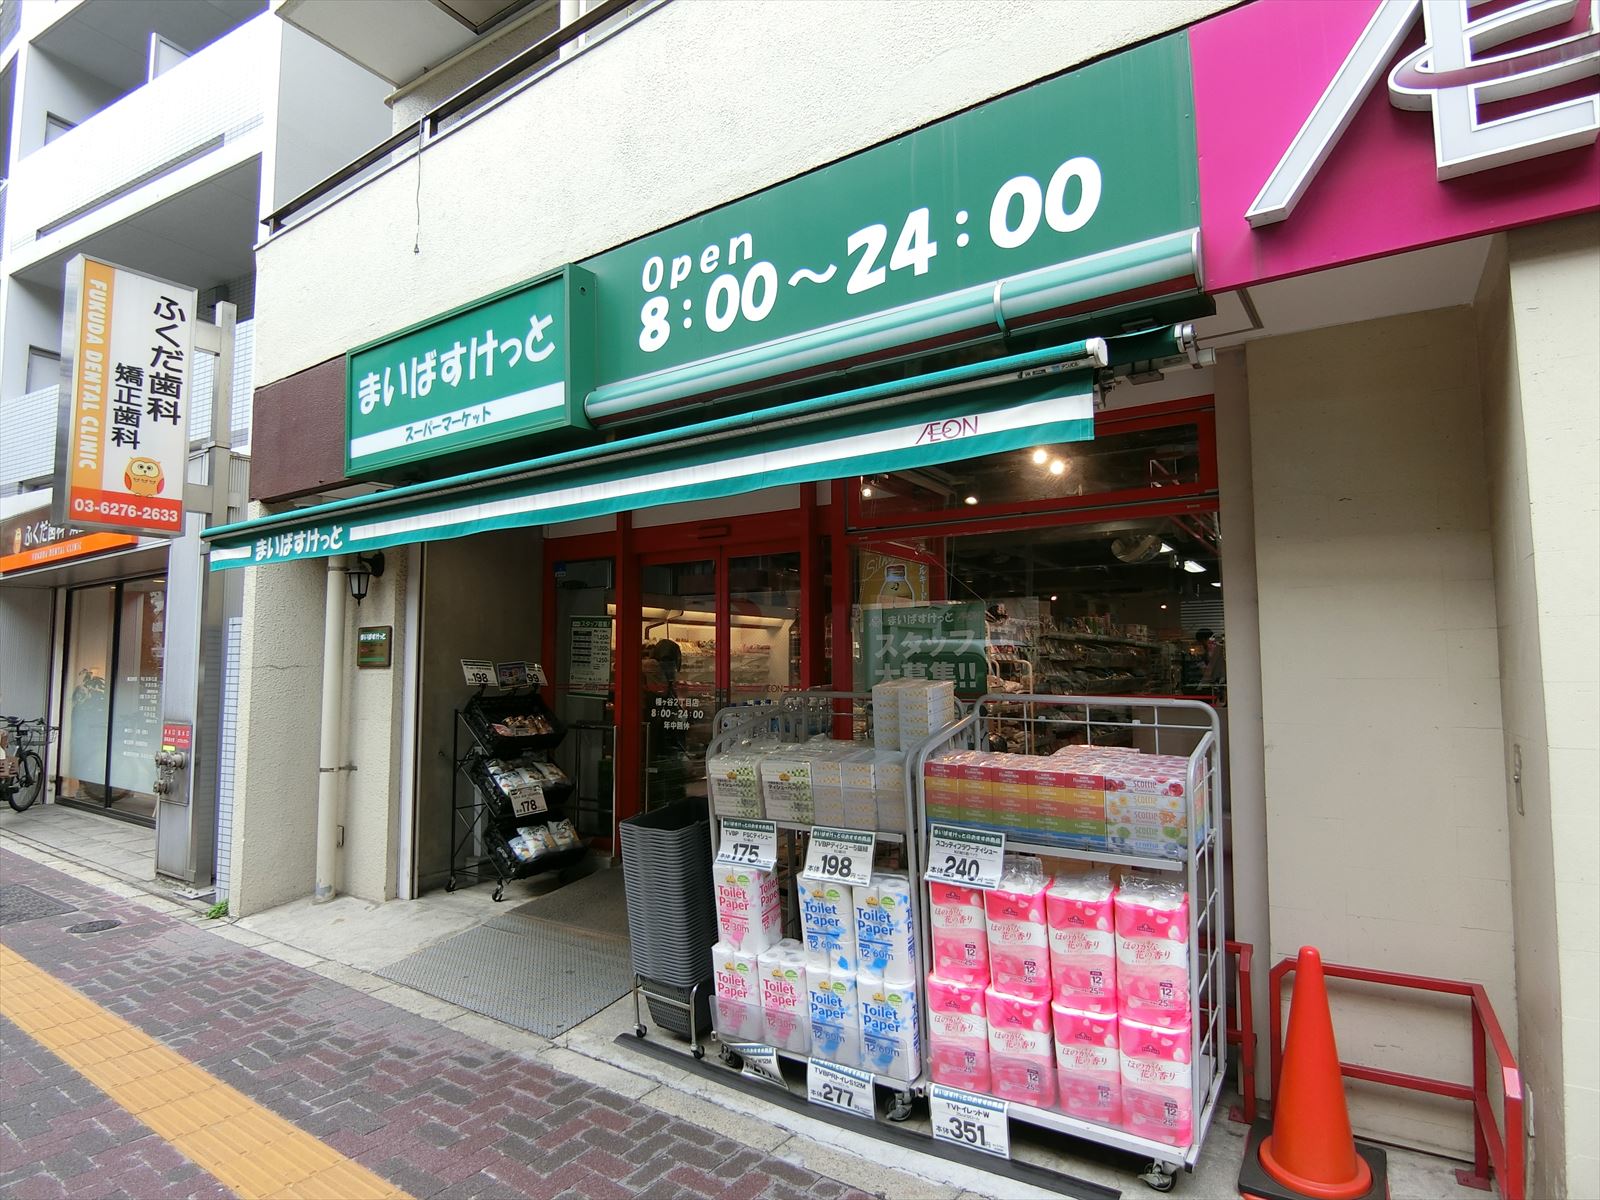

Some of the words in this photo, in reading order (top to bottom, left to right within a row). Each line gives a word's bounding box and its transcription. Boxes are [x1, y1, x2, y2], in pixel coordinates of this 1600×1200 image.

[641, 232, 753, 293] Open
[86, 279, 107, 344] FUKUDA
[147, 296, 186, 425] ふくだ歯科
[358, 313, 556, 416] まいばすけっと
[82, 351, 104, 411] DENTAL
[111, 362, 144, 449] 矯正歯科
[405, 406, 491, 442] スーパーマーケット
[79, 416, 100, 470] CLINIC
[74, 498, 178, 522] 03-6276-2633
[255, 525, 344, 561] まいばすけっと
[887, 612, 954, 625] まいばすけっと
[875, 630, 975, 659] スタッフ
[472, 673, 488, 683] 198
[521, 799, 538, 813] 178
[732, 843, 760, 863] 175
[821, 854, 852, 878] 198
[930, 866, 943, 874] 本体
[943, 855, 980, 882] 240
[718, 885, 746, 899] Toilet
[719, 897, 750, 911] Paper
[804, 900, 837, 914] Toilet
[805, 913, 840, 927] Paper
[857, 907, 892, 923] Toilet
[722, 922, 730, 931] 12
[858, 921, 894, 936] Paper
[809, 940, 818, 949] 12
[860, 948, 870, 958] 12
[966, 948, 976, 957] 12
[1026, 965, 1036, 974] 12
[717, 970, 746, 987] Toilet
[763, 978, 795, 995] Toilet
[1091, 975, 1102, 984] 12
[718, 982, 748, 998] Paper
[764, 990, 797, 1007] Paper
[809, 990, 843, 1007] Toilet
[1161, 987, 1172, 997] 12
[811, 1003, 846, 1019] Paper
[863, 1002, 899, 1020] Toilet
[864, 1014, 901, 1032] Paper
[813, 1029, 823, 1039] 12
[866, 1042, 875, 1052] 12
[822, 1082, 854, 1107] 277
[936, 1124, 949, 1134] 本体
[949, 1116, 986, 1147] 351
